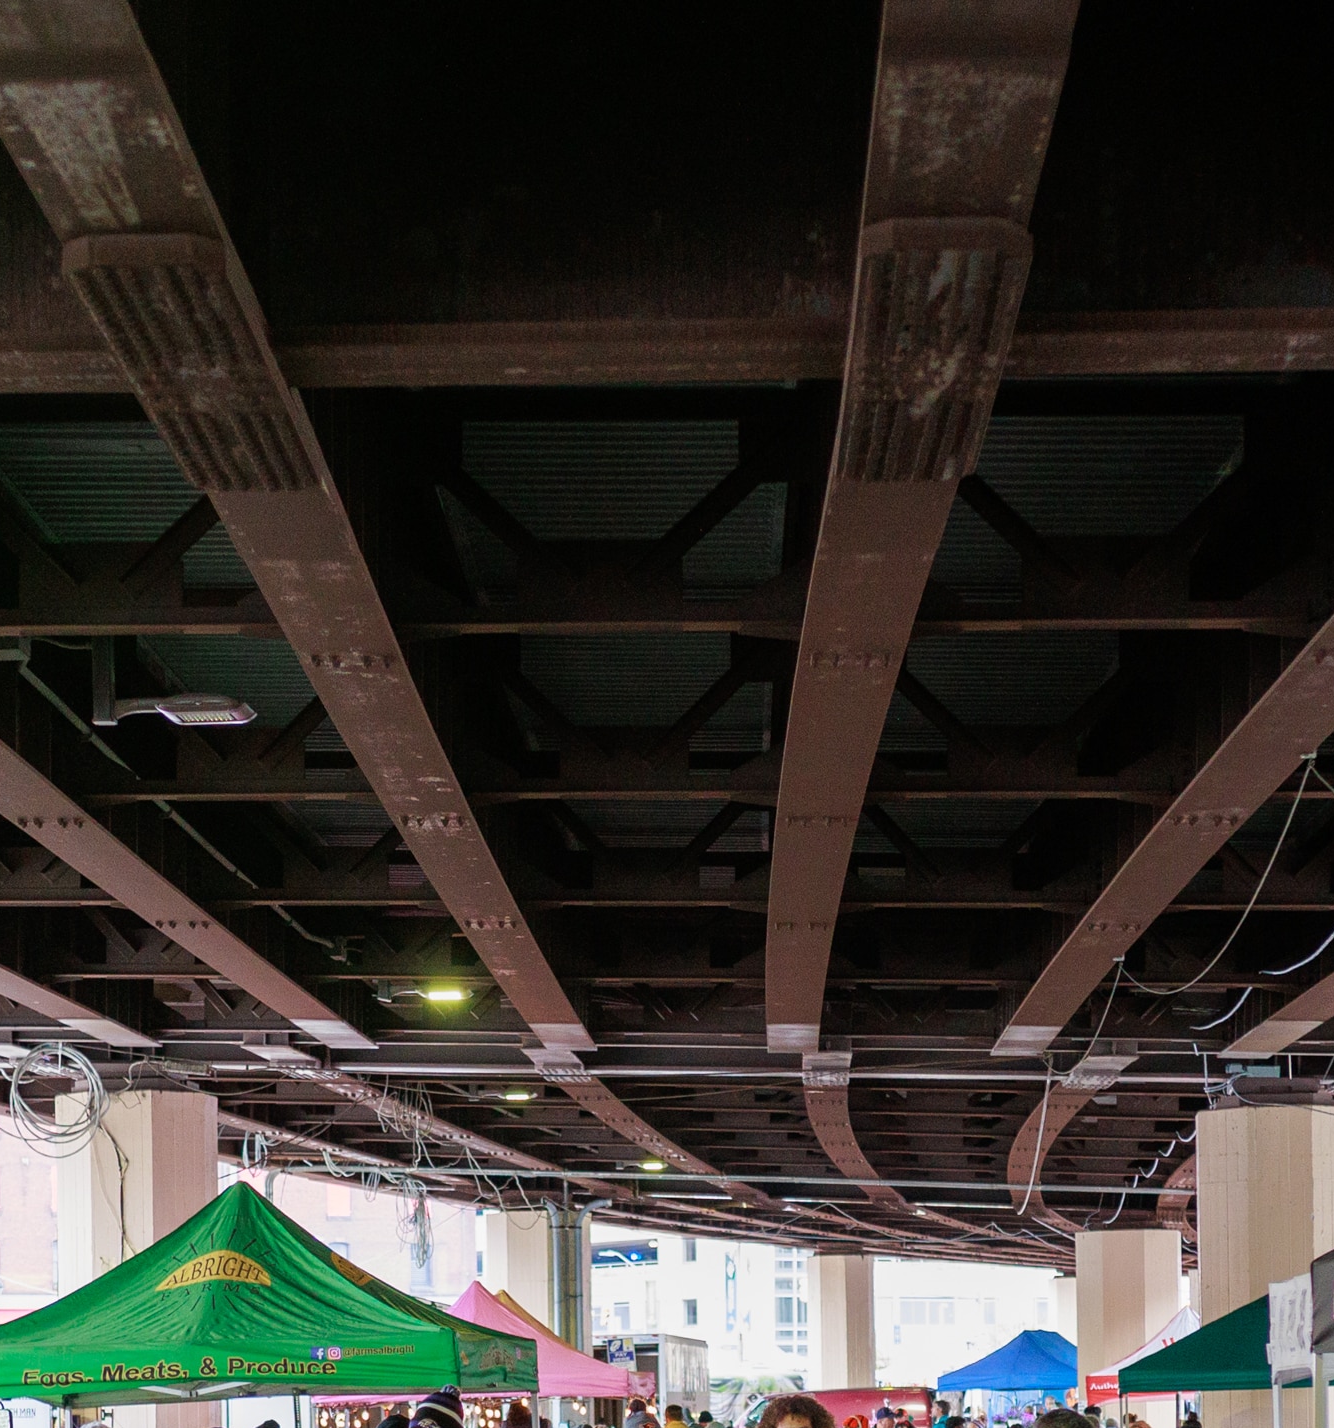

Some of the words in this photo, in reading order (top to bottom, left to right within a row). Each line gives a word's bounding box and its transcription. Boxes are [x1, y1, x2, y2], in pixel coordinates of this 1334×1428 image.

[166, 1255, 264, 1287] ALBRIGHT
[160, 1283, 261, 1302] FARMS
[343, 1345, 415, 1358] @farmsalbright
[102, 1361, 189, 1382] Meats,
[199, 1357, 217, 1377] &
[228, 1358, 337, 1376] Produce
